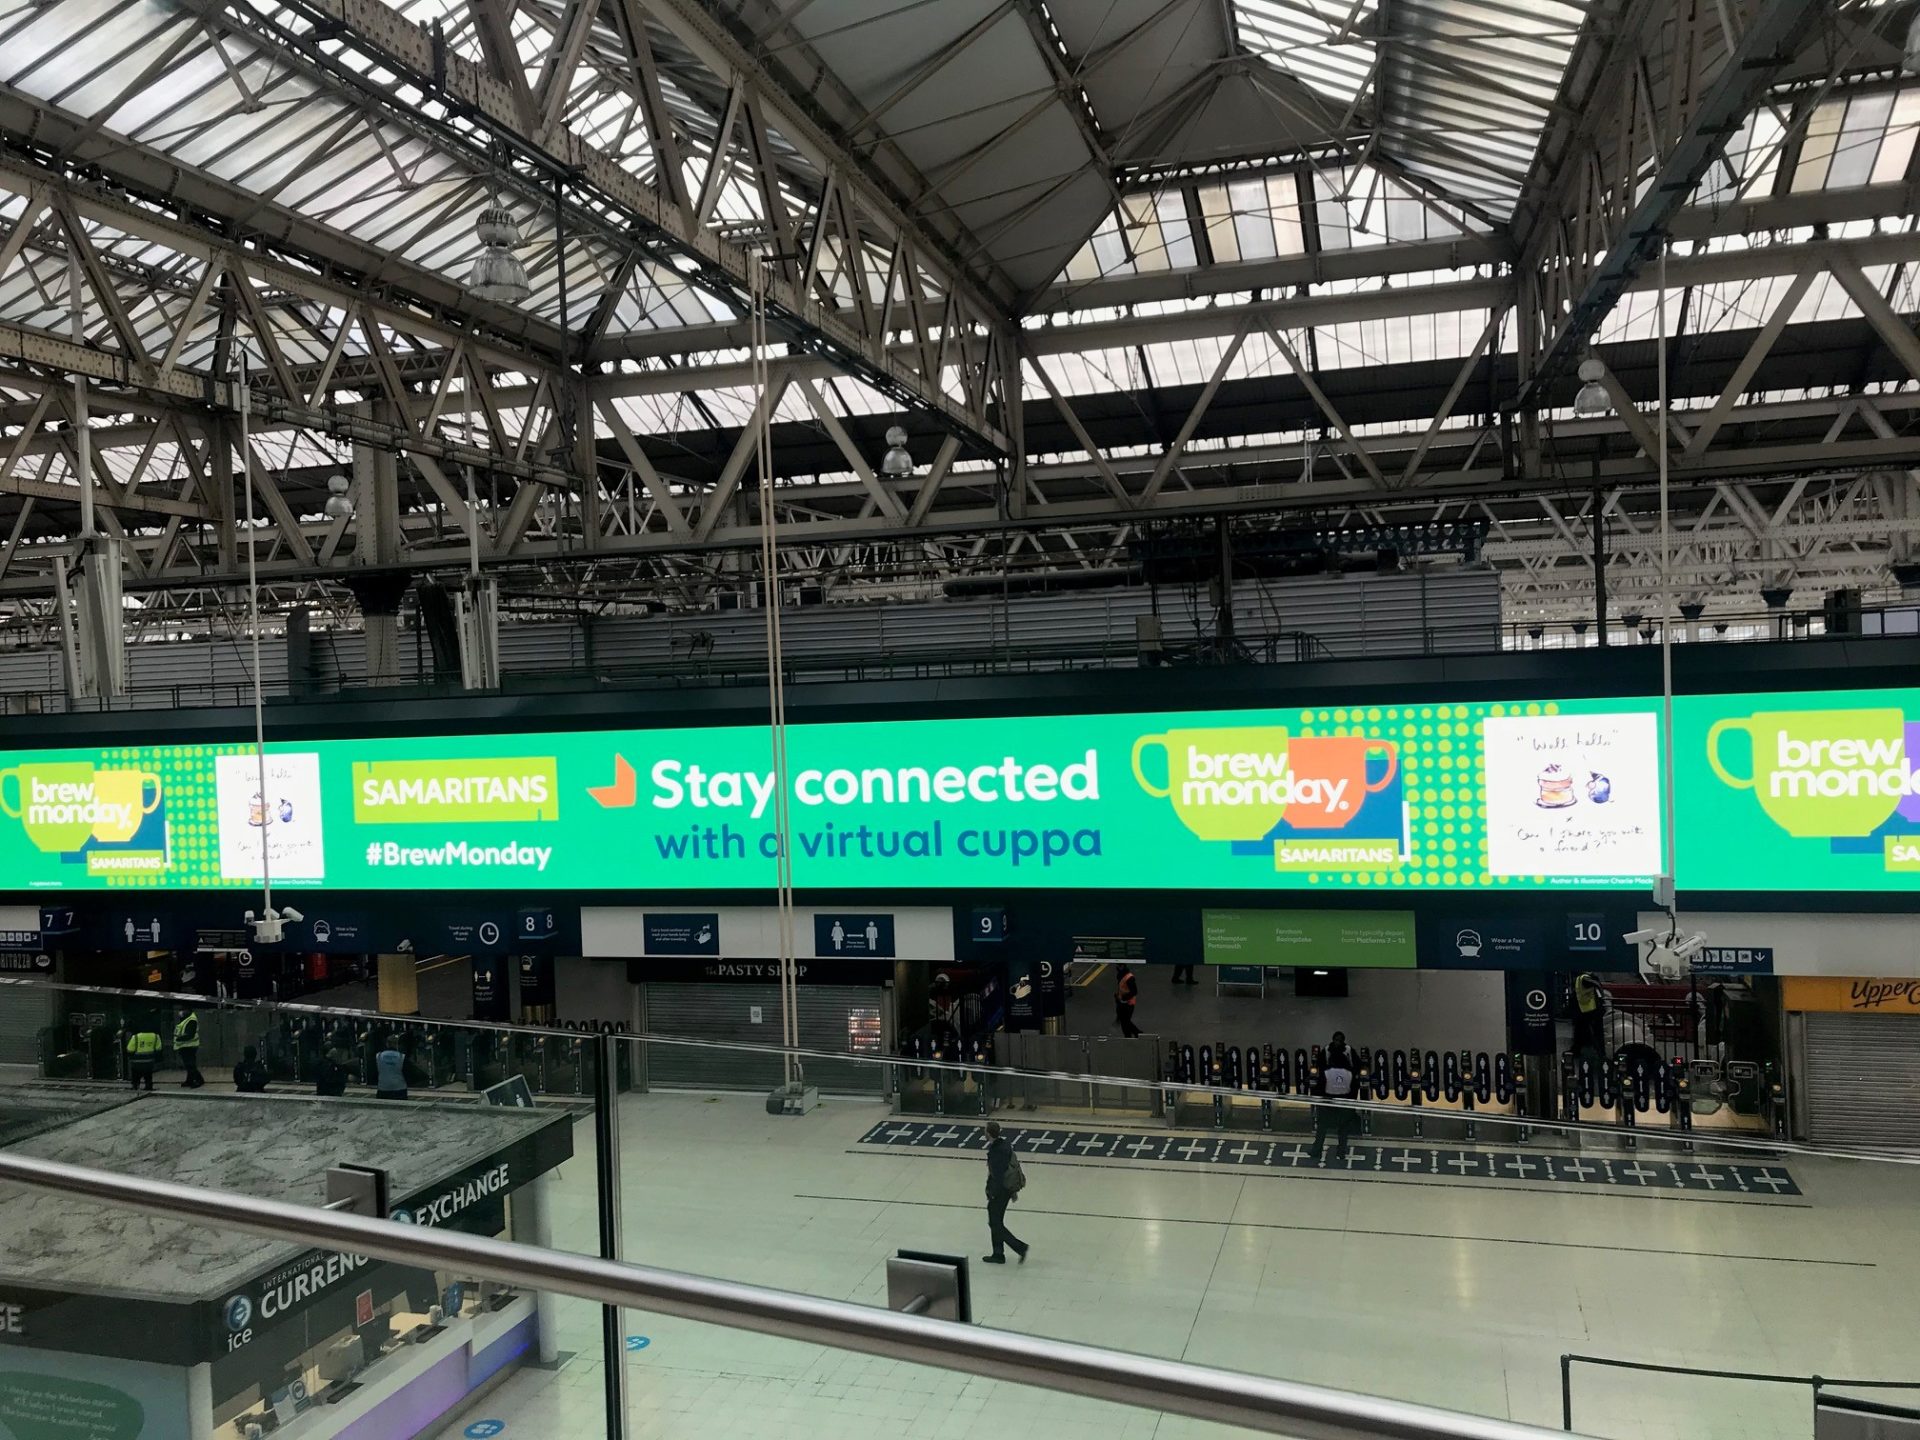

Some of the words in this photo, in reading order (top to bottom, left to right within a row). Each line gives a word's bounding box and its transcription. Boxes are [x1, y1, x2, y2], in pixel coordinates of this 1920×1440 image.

[1187, 745, 1288, 778] brew
[1778, 730, 1903, 768] brew
[31, 777, 96, 803] brew
[362, 775, 549, 806] SAMARITANS
[651, 759, 776, 818] Stay
[794, 749, 1100, 806] connected
[366, 840, 552, 872] #BrewMonday
[654, 822, 744, 859] with
[758, 831, 785, 858] a
[799, 819, 943, 858] virtual
[957, 827, 1102, 866] cuppa
[1279, 848, 1394, 864] SAMARITANS
[90, 856, 161, 870] SAMARITANS
[45, 914, 54, 928] 7
[65, 911, 75, 926] 7
[525, 916, 536, 932] 8
[546, 914, 554, 929] 8
[981, 917, 992, 933] 9
[1574, 923, 1602, 941] 10
[719, 964, 763, 977] PASTY
[1851, 980, 1917, 1009] Upper
[261, 1251, 369, 1319] CURRENC
[415, 1163, 510, 1228] EXCHANGE
[262, 1251, 325, 1291] INTERNATIONAL
[227, 1328, 253, 1352] ice
